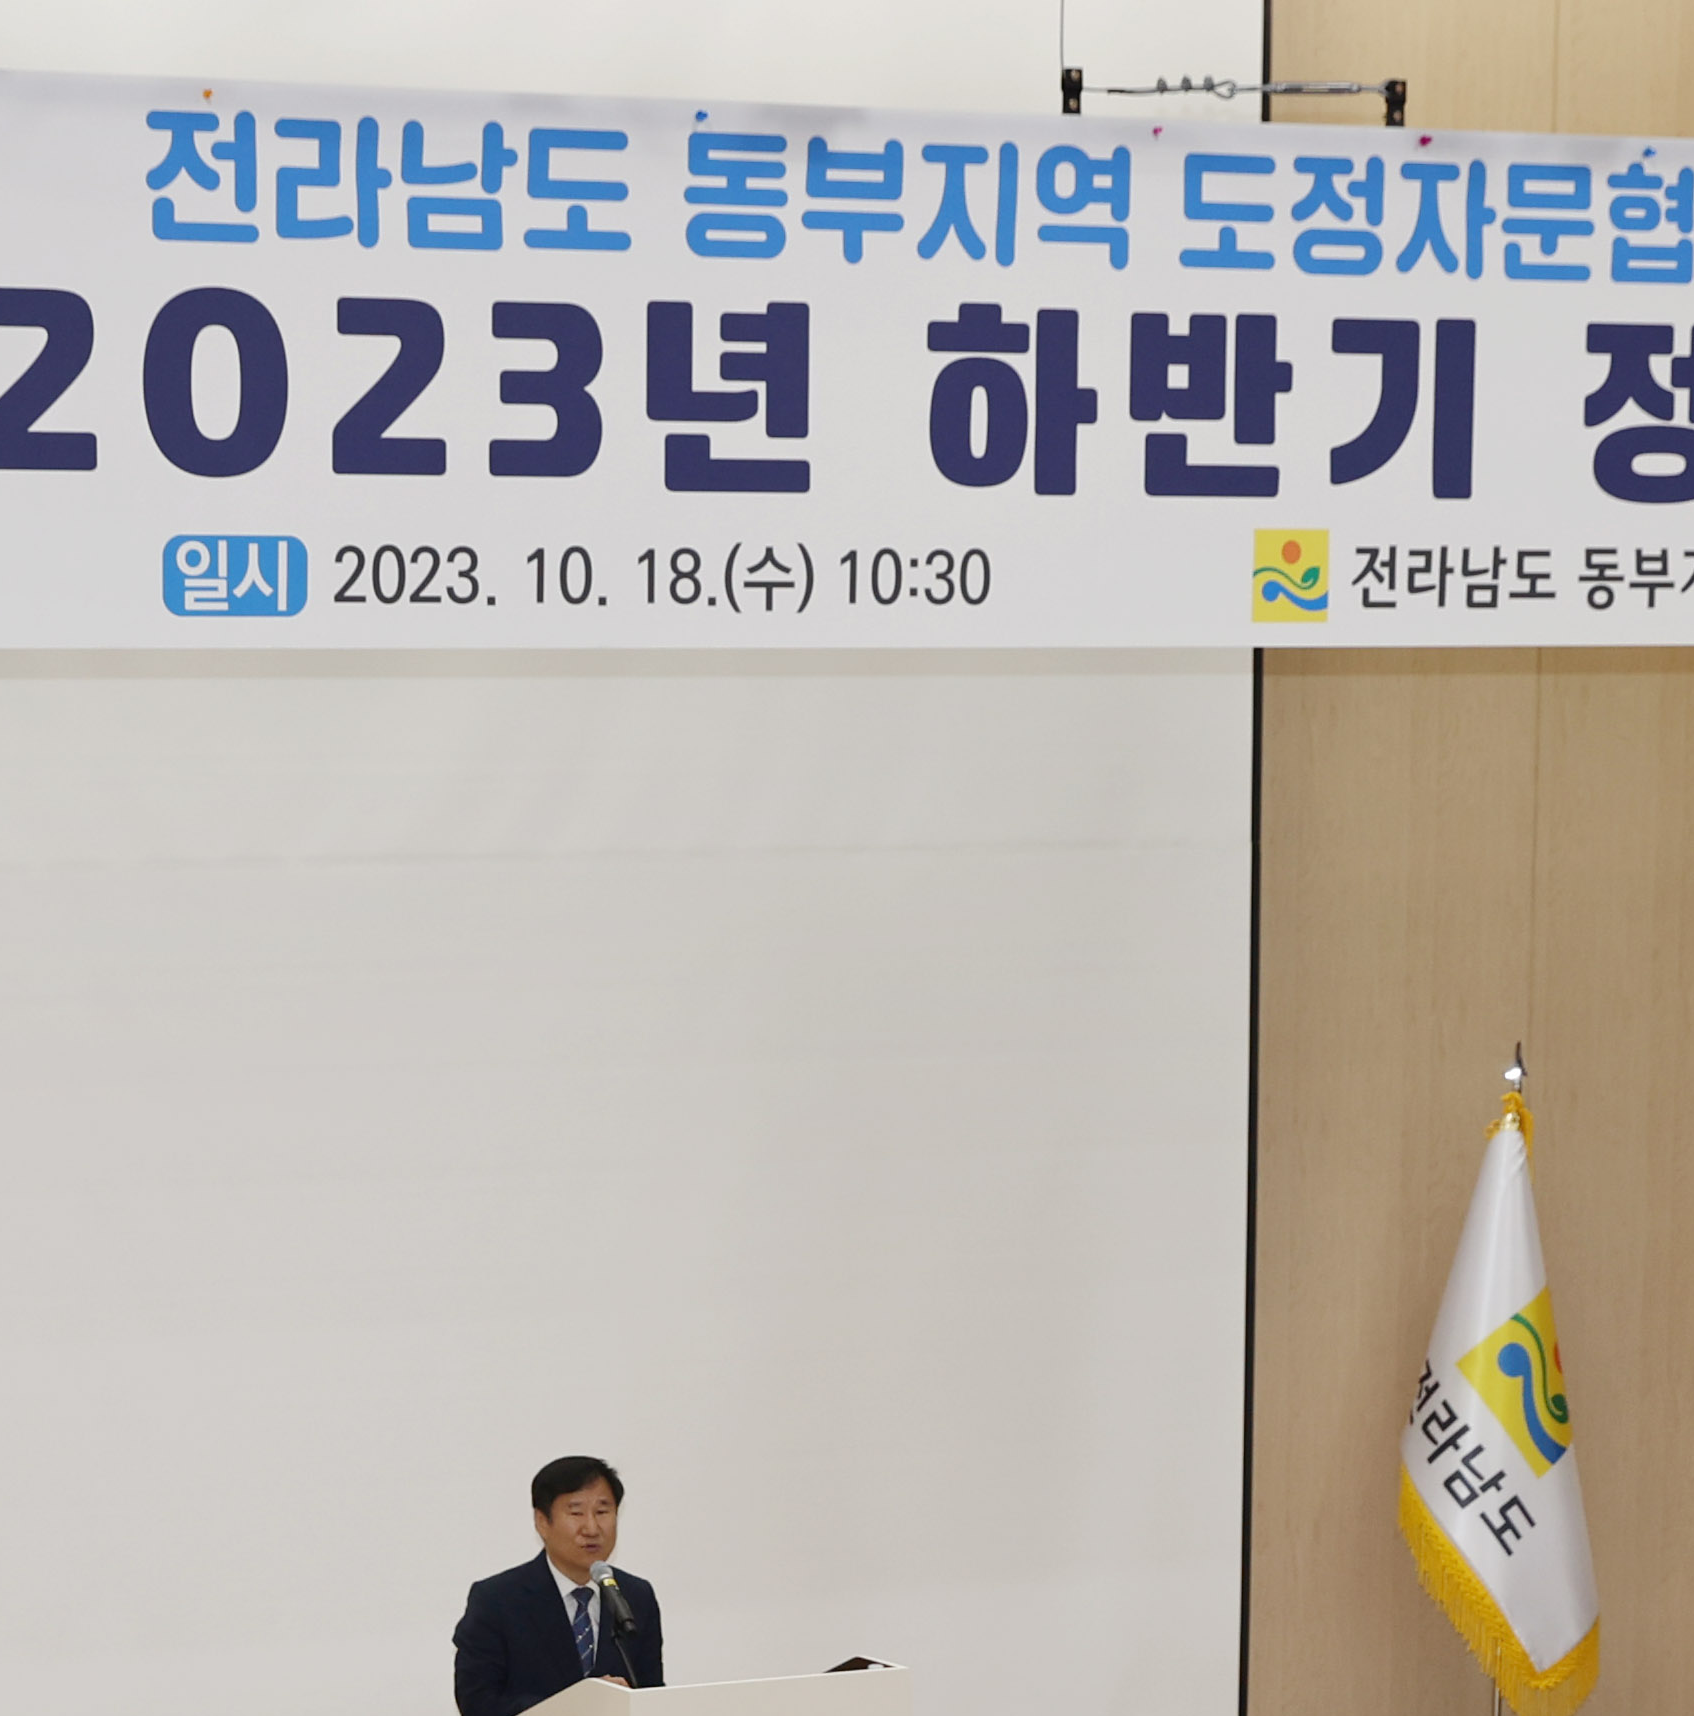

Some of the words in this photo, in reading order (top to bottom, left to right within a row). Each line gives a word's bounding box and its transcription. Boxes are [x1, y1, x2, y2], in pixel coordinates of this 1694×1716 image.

[145, 110, 632, 252] 전라남도
[683, 131, 1133, 271] 동부지역
[925, 301, 1479, 501] 하반기
[175, 540, 289, 612] 일시
[332, 543, 498, 607] 2023.
[525, 545, 609, 607] 10.
[636, 541, 815, 614] 18.(수)
[838, 546, 991, 606] 10:30
[1350, 543, 1558, 610] 전라남도
